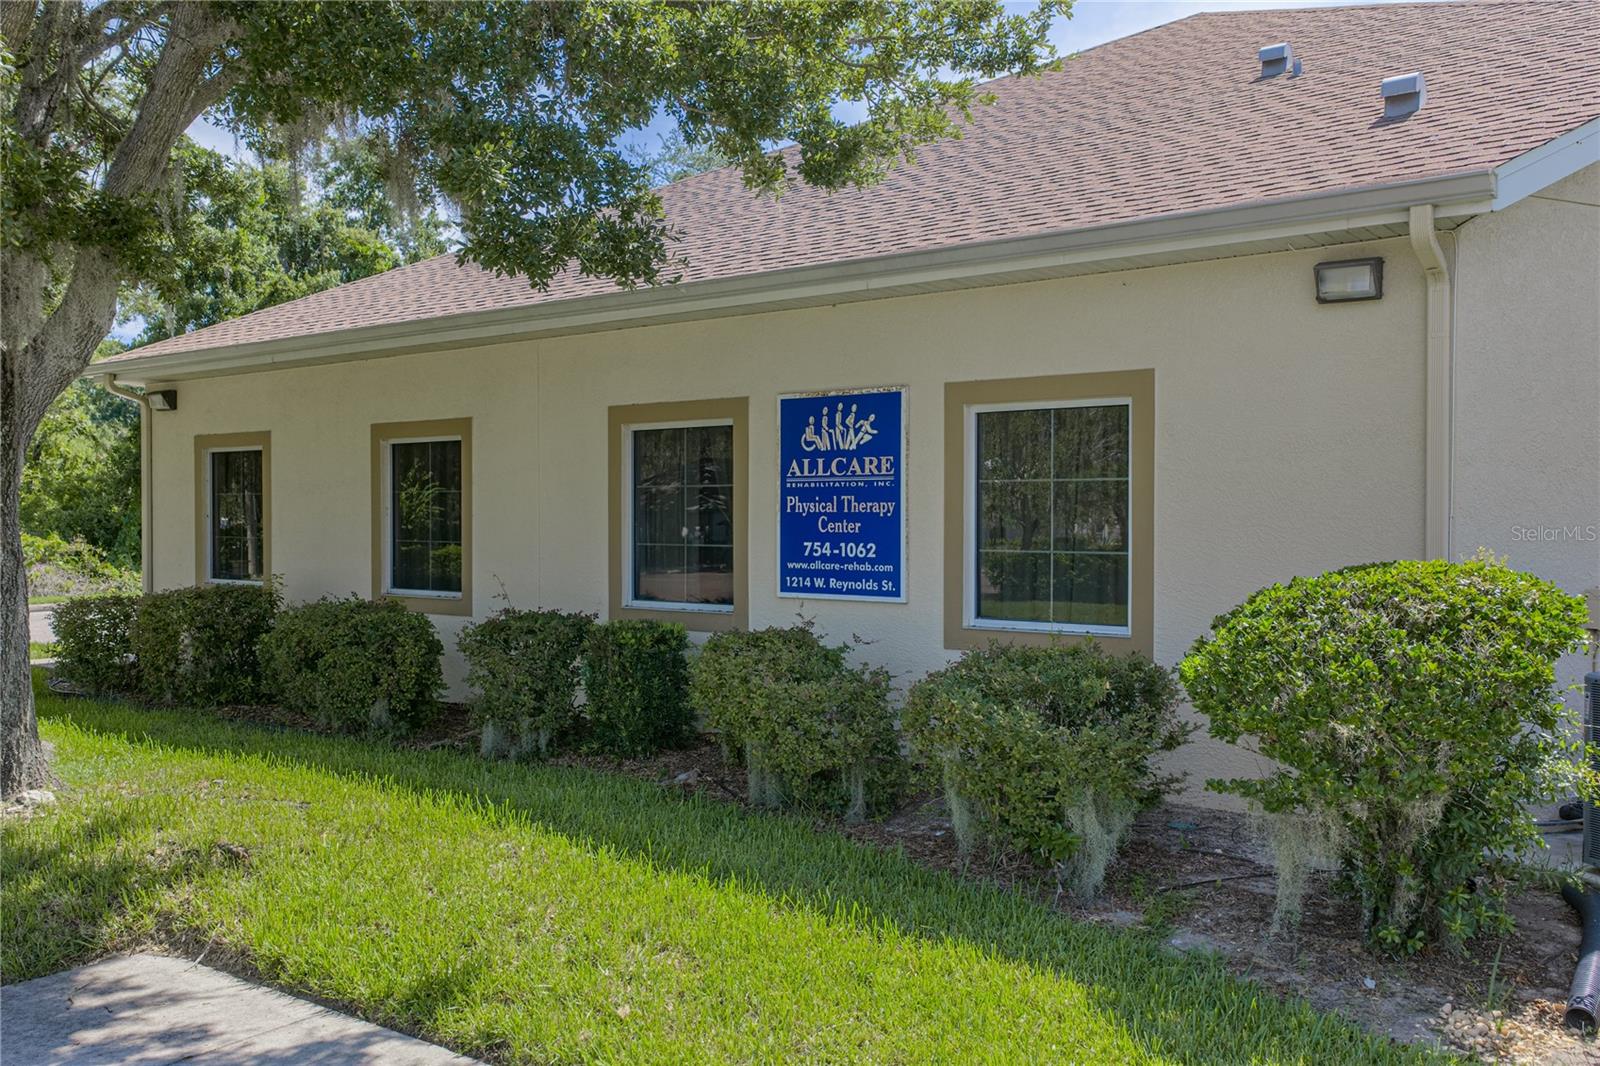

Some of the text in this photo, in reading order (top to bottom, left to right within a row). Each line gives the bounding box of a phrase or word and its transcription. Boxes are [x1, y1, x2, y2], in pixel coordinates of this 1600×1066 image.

[786, 456, 895, 477] ALLCARE
[786, 495, 896, 517] Physical Therapy
[818, 515, 861, 533] Center
[803, 541, 877, 558] 754-1062
[786, 560, 894, 572] www.allcare-rehab.com
[785, 576, 896, 592] 1214 W. Reynolds St.
